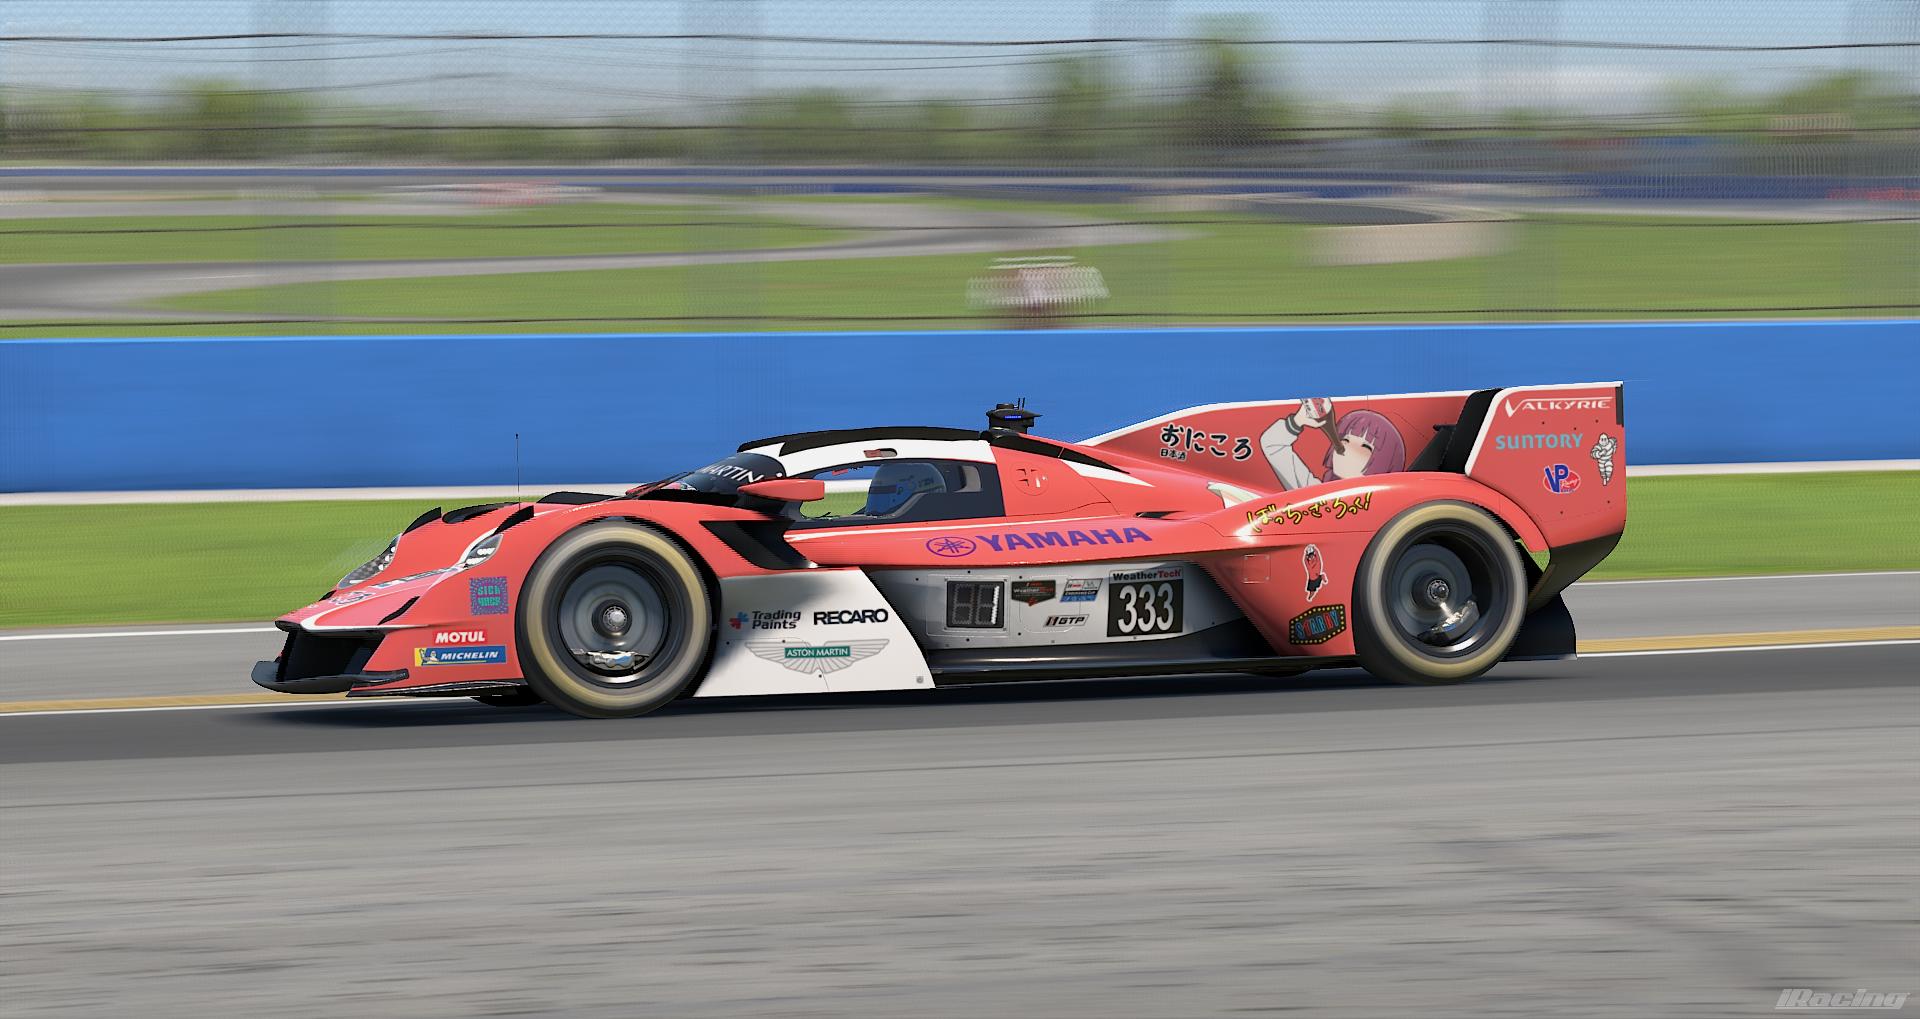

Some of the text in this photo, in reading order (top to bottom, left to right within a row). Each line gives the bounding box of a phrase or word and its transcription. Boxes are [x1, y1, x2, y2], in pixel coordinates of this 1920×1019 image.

[1505, 397, 1612, 418] VALKYRIE
[1161, 423, 1252, 460] おにころ
[700, 464, 765, 483] MARTIN
[1544, 463, 1569, 493] VP
[975, 527, 1152, 552] YAMAHA
[1112, 569, 1182, 581] WeatherTech
[1118, 582, 1174, 633] 333
[752, 610, 801, 622] Trading
[813, 608, 889, 625] RECARO
[1058, 617, 1085, 625] GTP
[752, 620, 797, 629] Paints
[435, 631, 485, 643] MOTUL
[440, 651, 498, 660] MICHELIN
[787, 648, 848, 657] ASTON MARTIN
